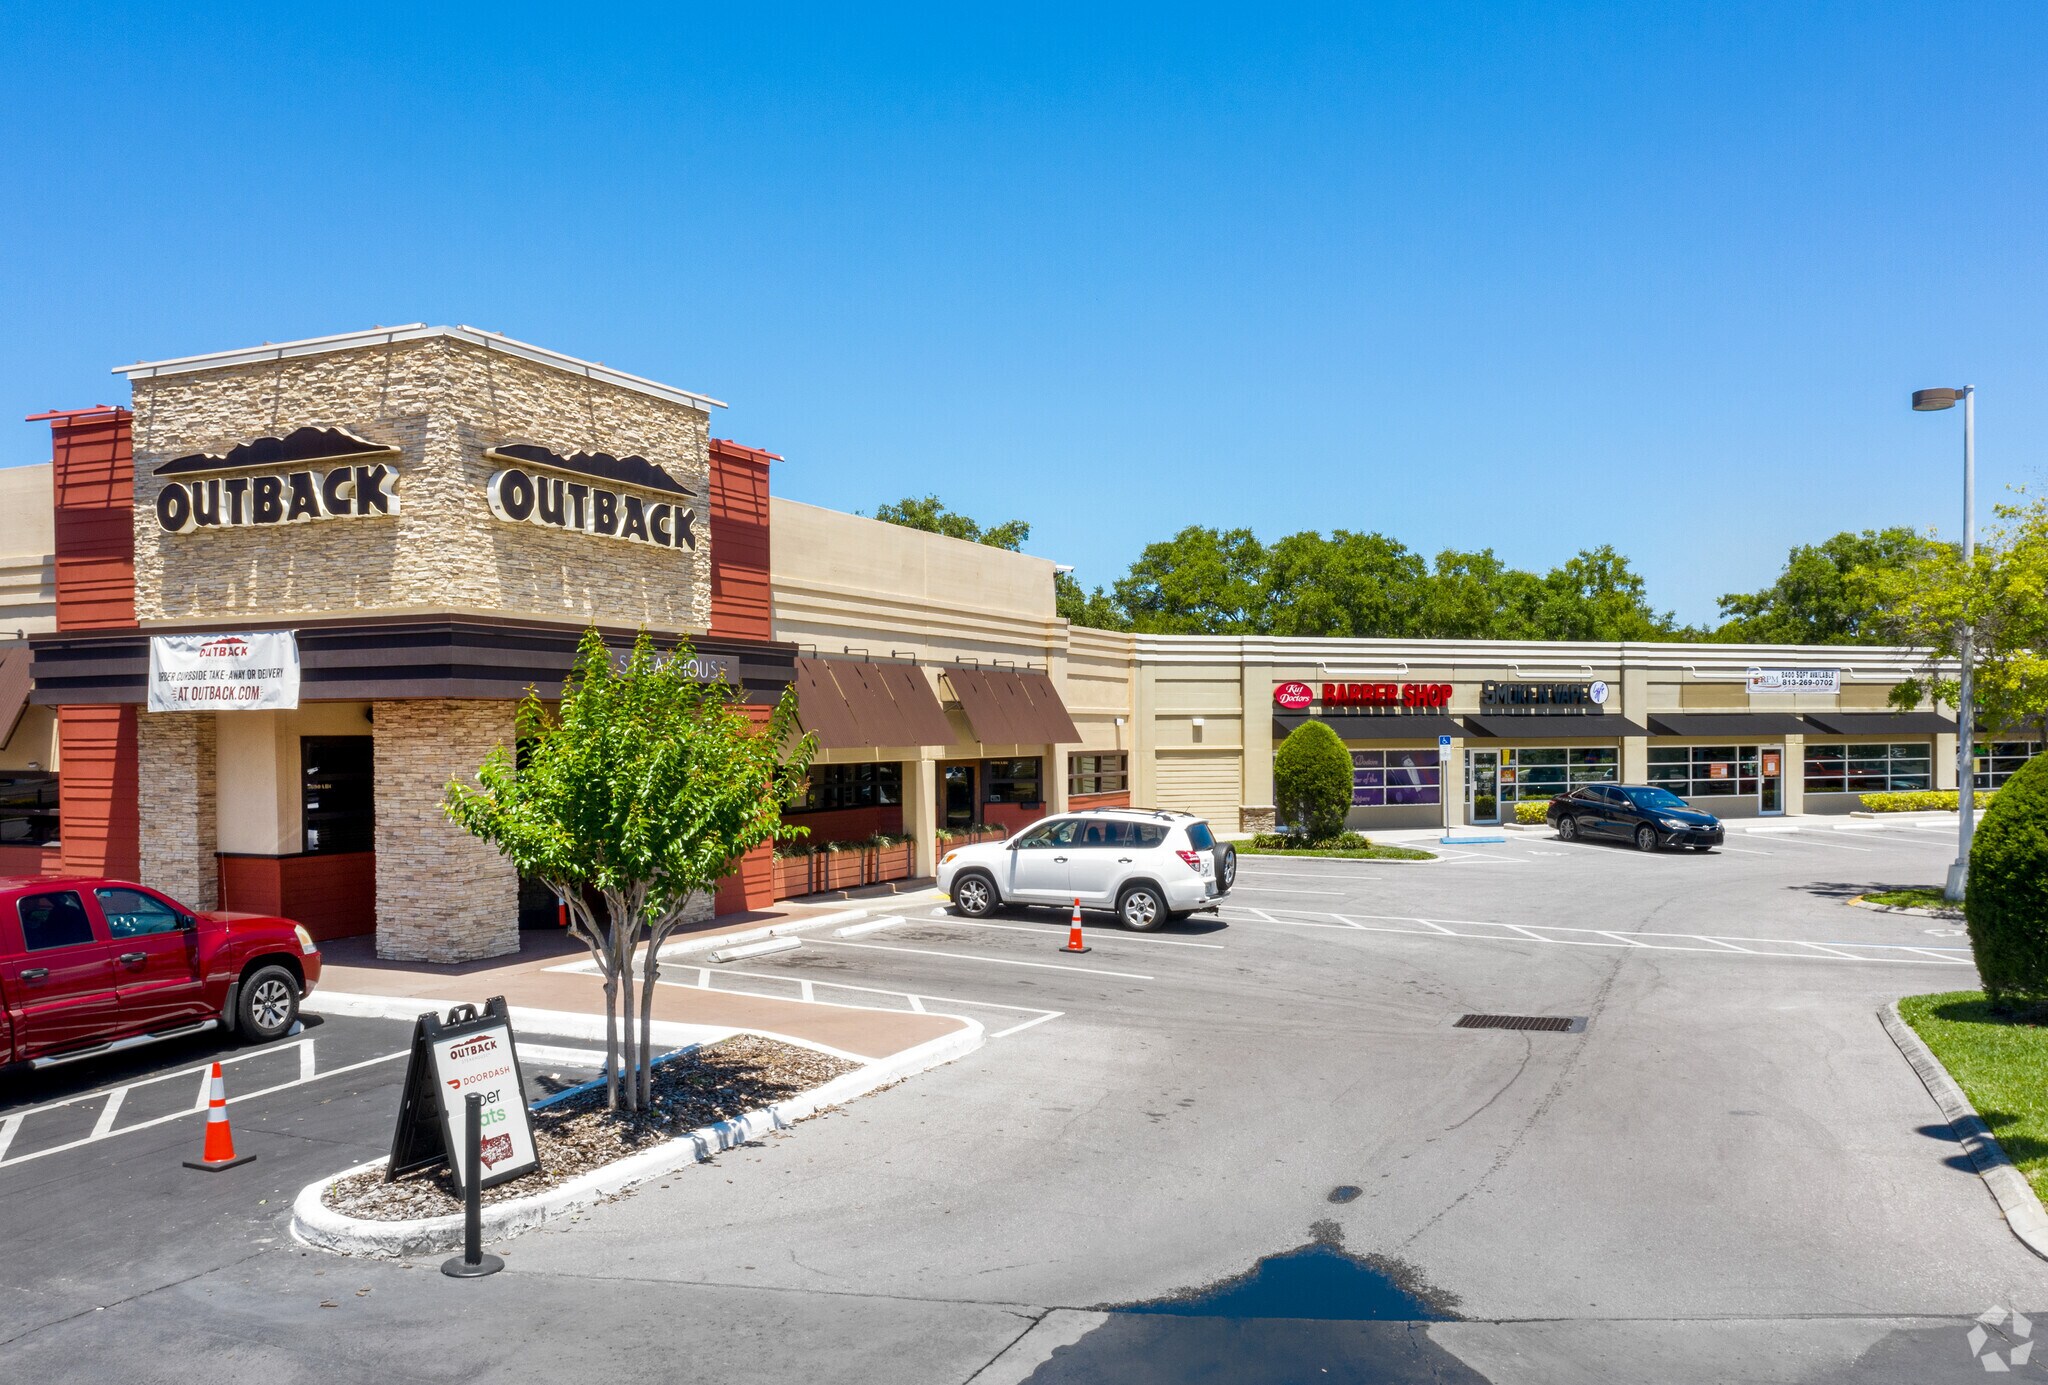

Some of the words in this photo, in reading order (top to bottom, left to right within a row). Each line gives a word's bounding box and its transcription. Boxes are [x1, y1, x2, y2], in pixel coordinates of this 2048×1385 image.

[156, 463, 400, 534] OUTBACK
[487, 468, 697, 552] OUTBACK
[199, 646, 248, 657] OUTBACK
[247, 669, 256, 680] OR
[178, 687, 188, 701] AT
[191, 685, 260, 701] OUTBACK.COM
[1280, 694, 1310, 703] Doctors
[1286, 684, 1303, 695] Kut
[1322, 683, 1398, 706] BARBER
[1402, 683, 1453, 707] SHOP
[1482, 680, 1538, 704] SMOKE
[1553, 684, 1588, 704] VAPE
[450, 1040, 498, 1060] OUTBACK
[463, 1066, 511, 1086] DOORDASH
[480, 1108, 506, 1126] ats
